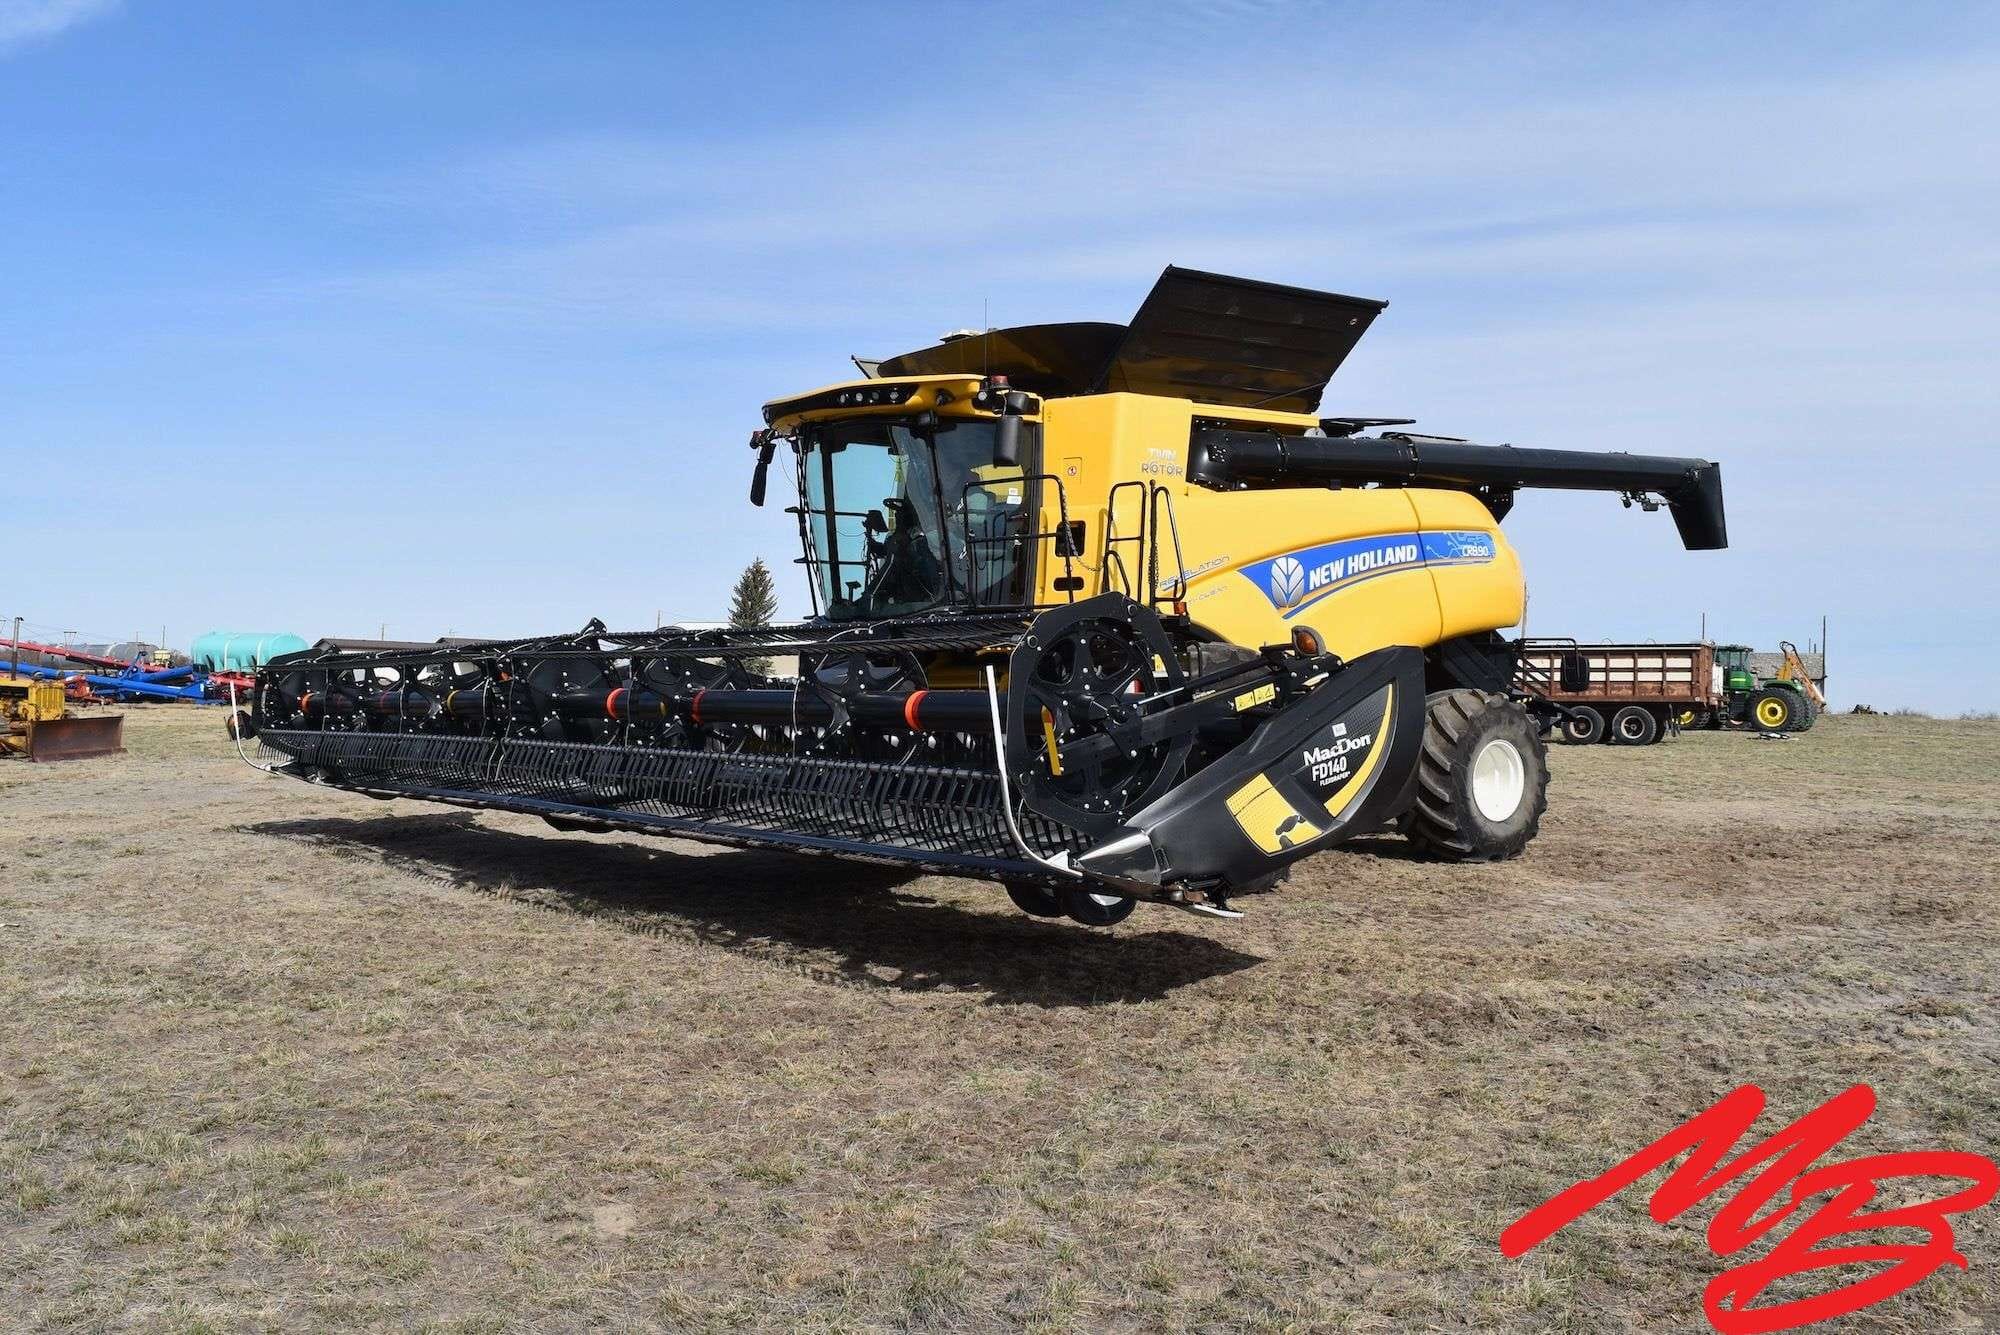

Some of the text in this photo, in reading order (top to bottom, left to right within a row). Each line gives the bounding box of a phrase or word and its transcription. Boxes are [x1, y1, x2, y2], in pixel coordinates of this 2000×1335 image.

[1146, 447, 1176, 461] TWIN
[1141, 462, 1183, 477] ROTOR
[1309, 544, 1417, 590] NEW HOLLAND
[1303, 734, 1372, 767] MacDon
[1312, 756, 1347, 782] FD140
